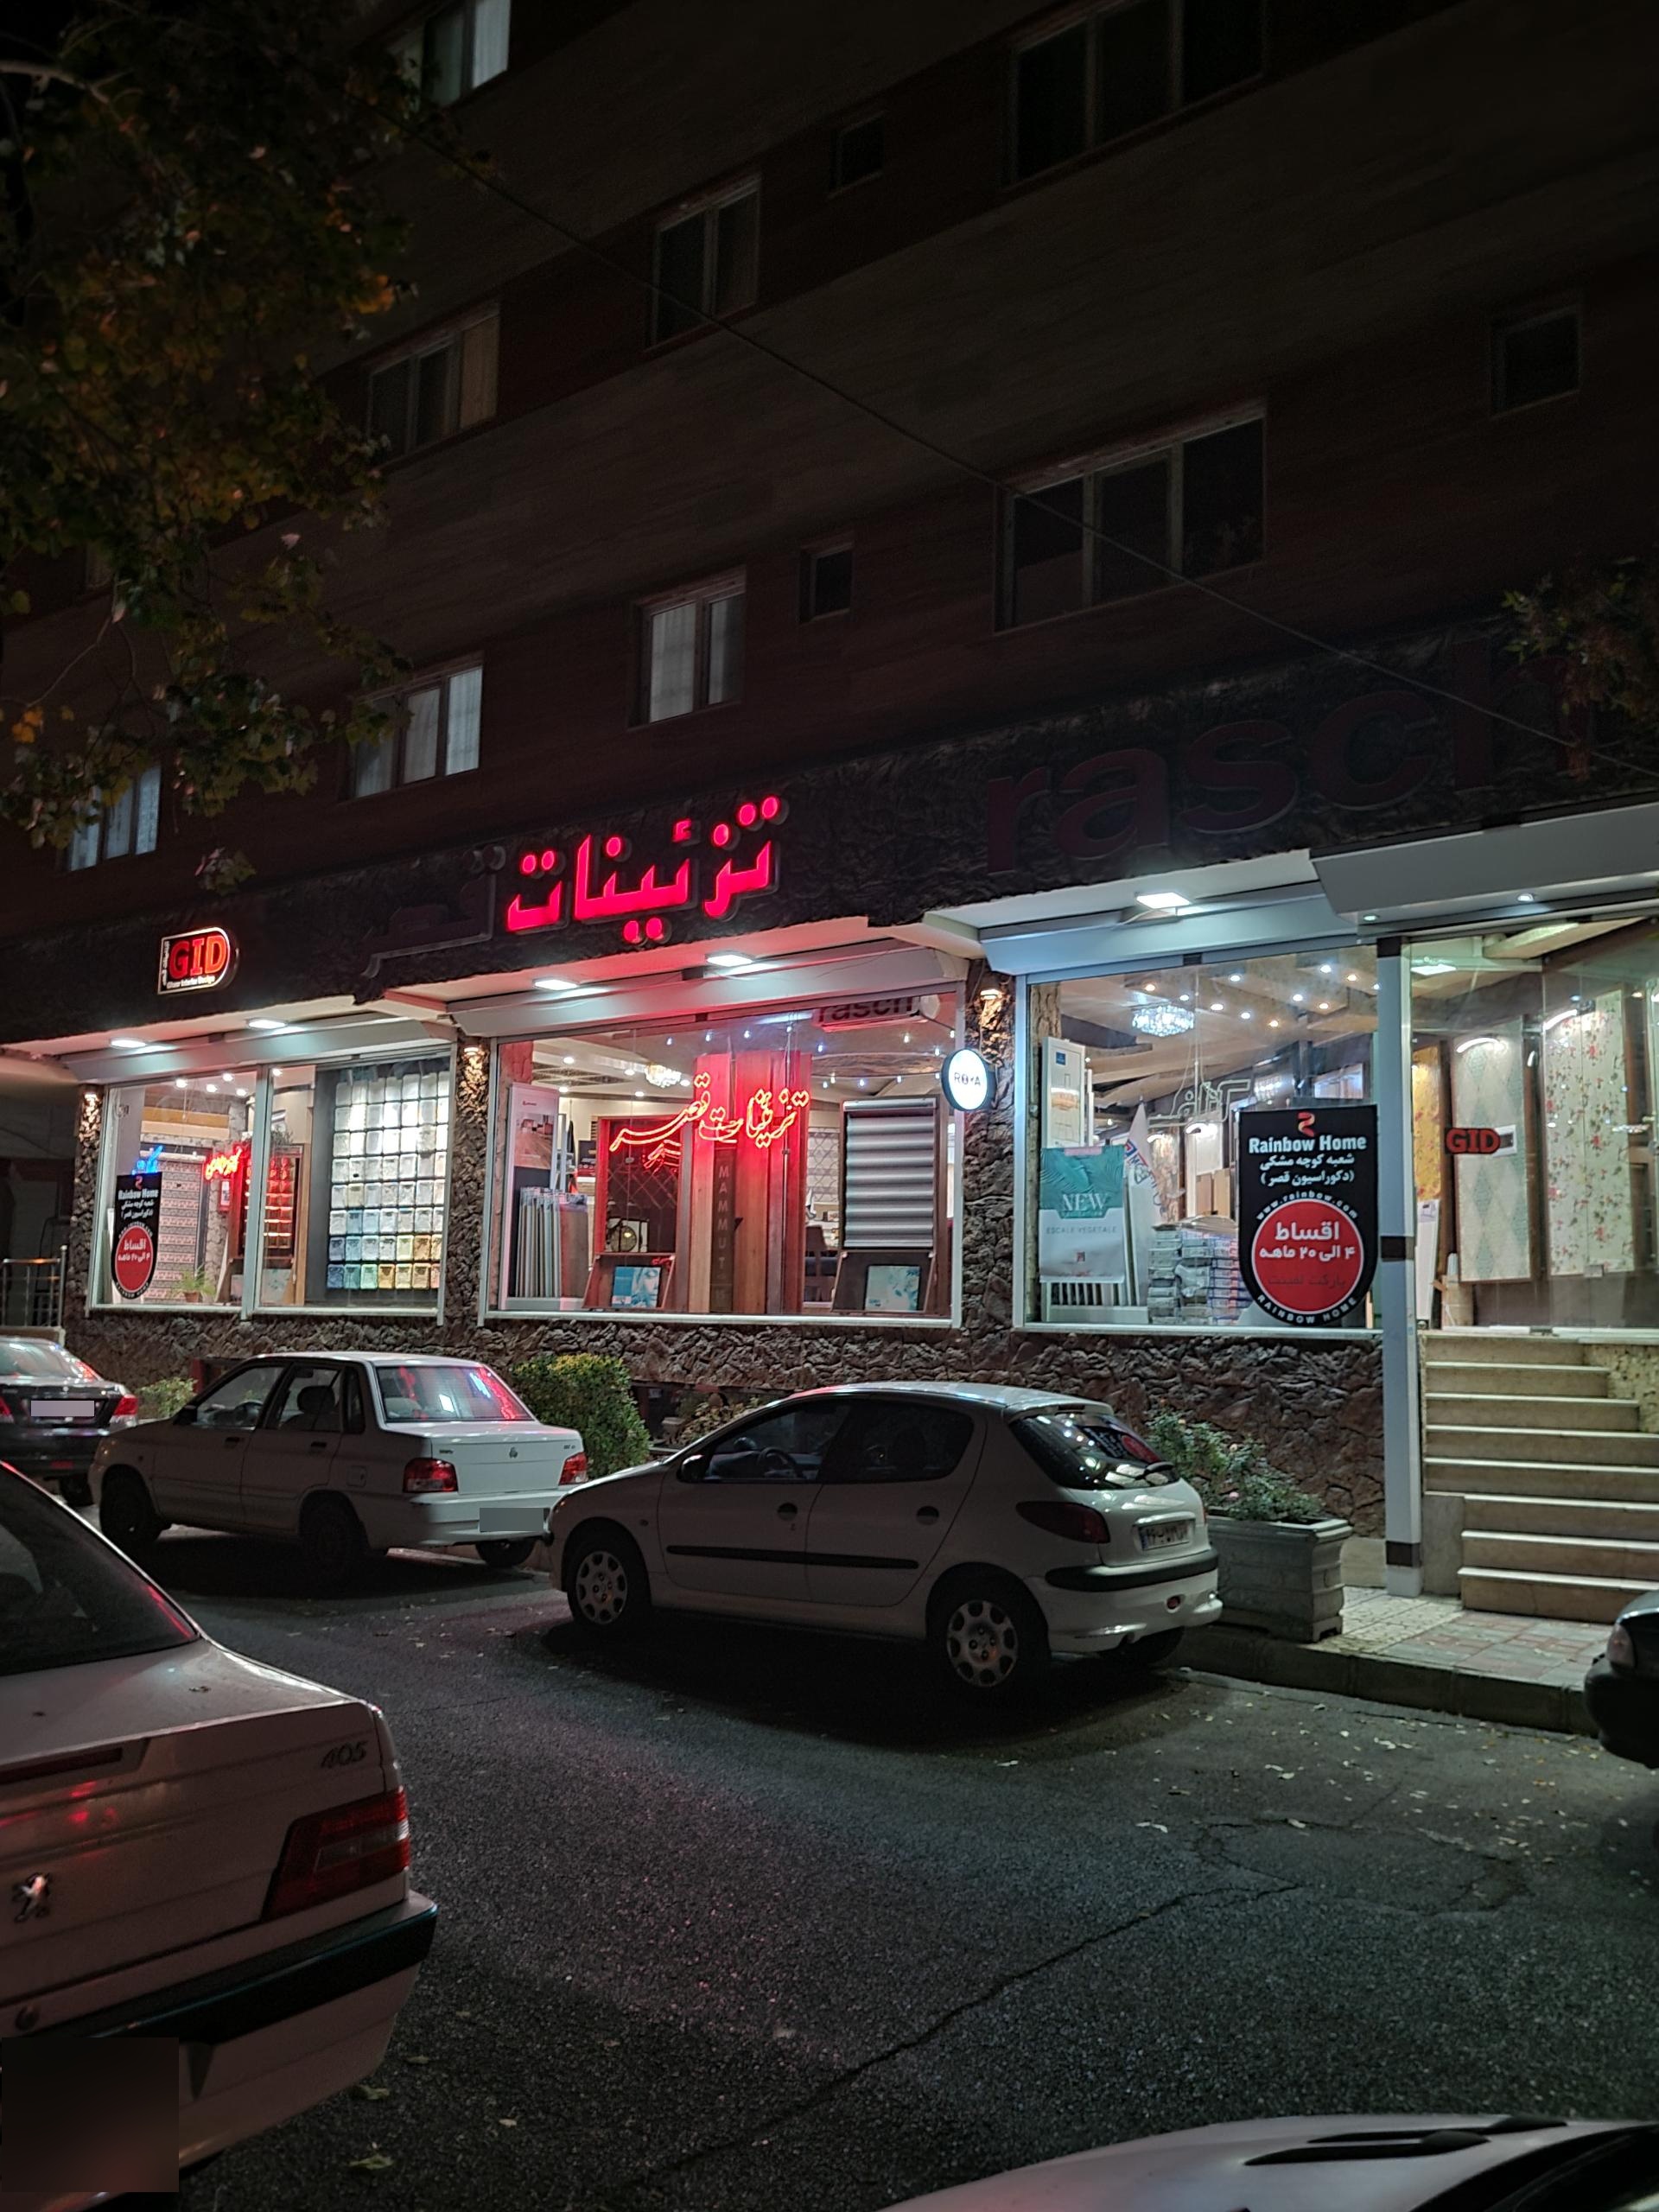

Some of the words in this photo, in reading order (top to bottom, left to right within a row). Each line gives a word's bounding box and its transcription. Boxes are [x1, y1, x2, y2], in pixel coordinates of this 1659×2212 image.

[986, 635, 1593, 875] rasch
[505, 796, 780, 944] تزئینات
[168, 934, 227, 980] GID
[1249, 1135, 1316, 1154] Rainbow
[1319, 1134, 1368, 1151] Home
[1446, 1128, 1501, 1154] GID
[1296, 1154, 1325, 1168] کوچه
[1326, 1153, 1355, 1166] شعبه
[1062, 1192, 1108, 1211] NEW
[717, 1166, 730, 1270] MAMMUT
[1274, 1220, 1340, 1241] اقساط
[1258, 1244, 1296, 1259] ماهه
[1319, 1244, 1342, 1262] الی
[1257, 1294, 1316, 1325] RAINBOW
[1321, 1297, 1357, 1322] HOME
[321, 1740, 369, 1769] 405
